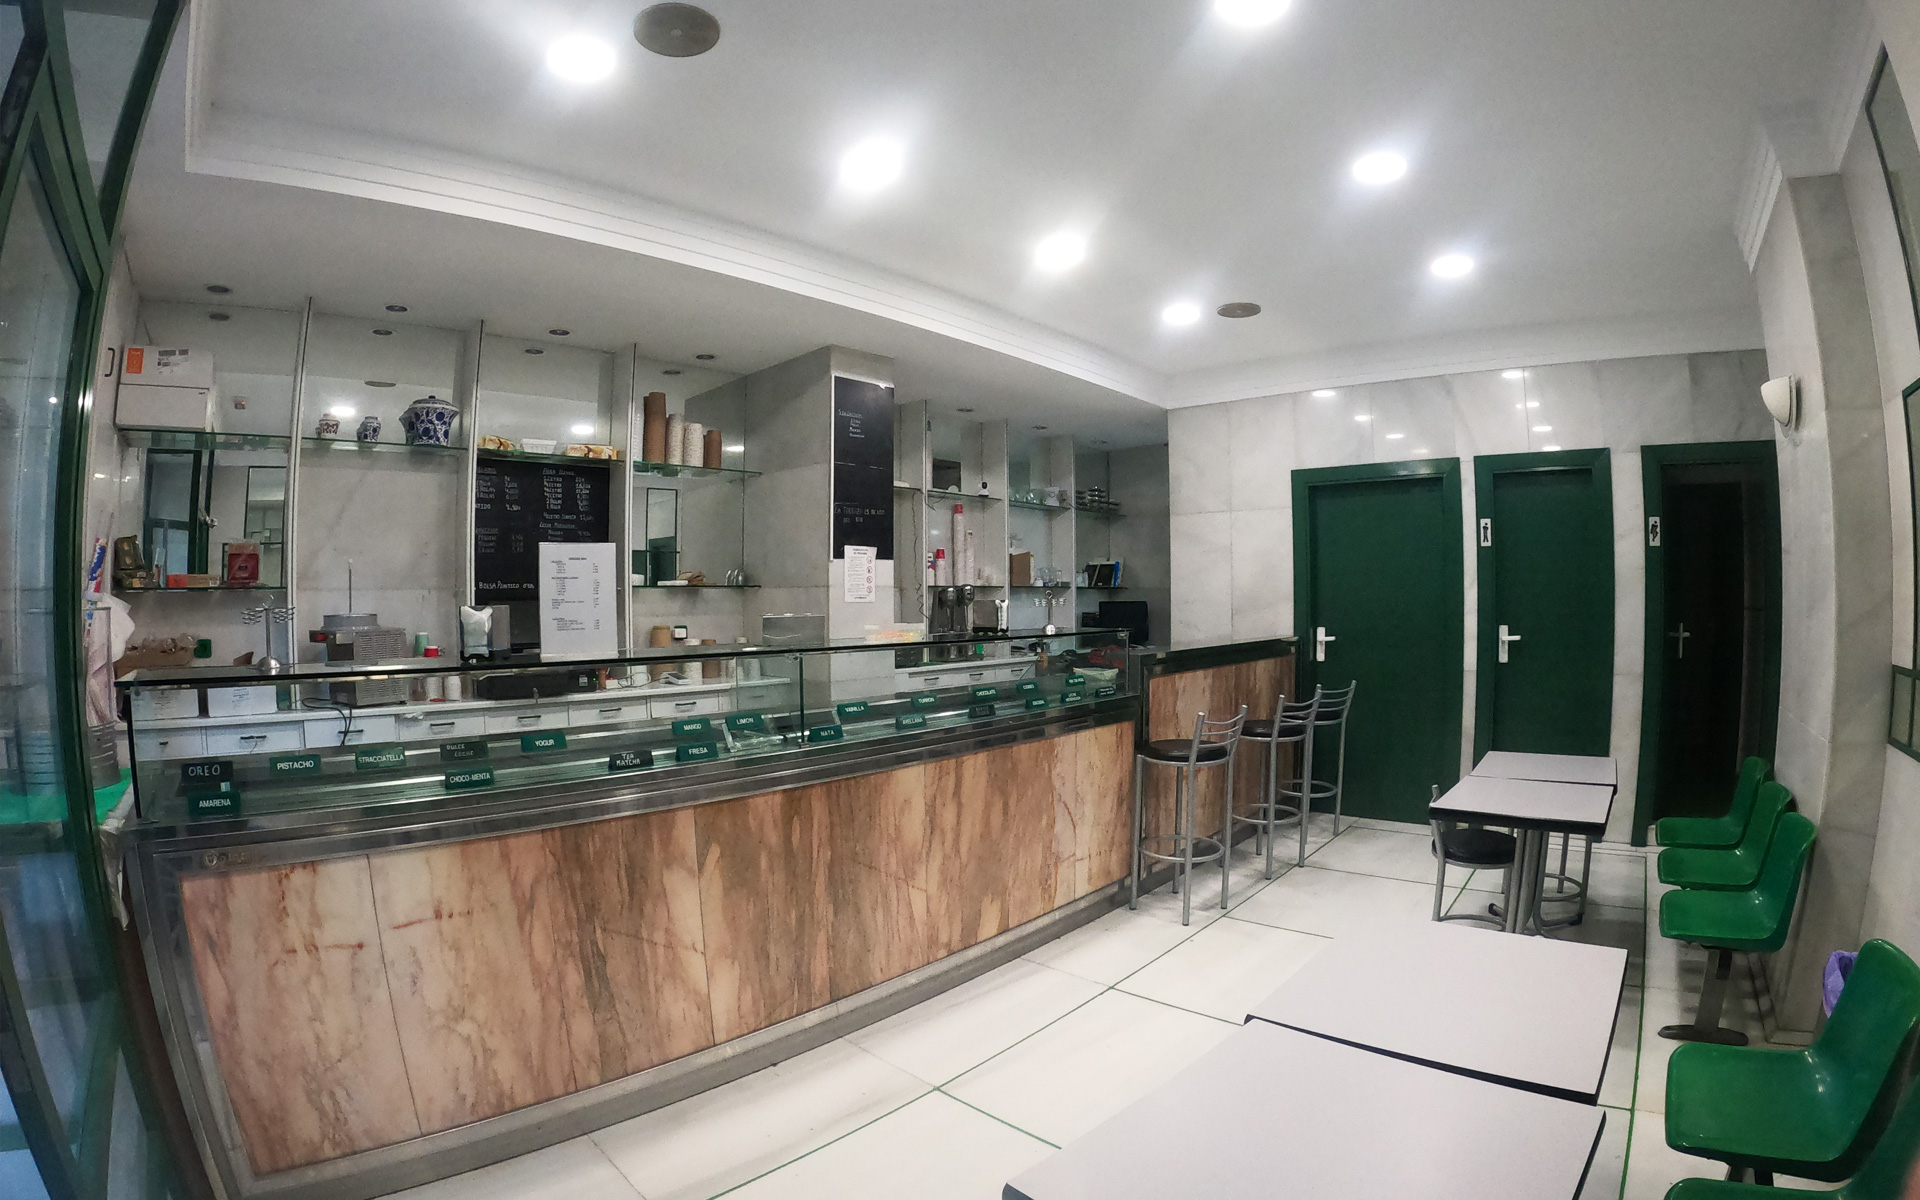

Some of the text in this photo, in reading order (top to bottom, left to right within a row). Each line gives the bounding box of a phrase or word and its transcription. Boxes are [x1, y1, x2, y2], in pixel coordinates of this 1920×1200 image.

[478, 581, 497, 589] BOLSA
[683, 723, 702, 731] MANGO
[534, 738, 555, 747] YOGUR
[688, 746, 708, 755] FRESA
[358, 753, 405, 764] STRACCIATELLA
[616, 758, 641, 767] MATCHA
[276, 759, 315, 771] PISTACHO
[187, 764, 221, 777] OREO
[449, 773, 491, 784] CHOCO-MENTA
[198, 798, 231, 809] AMARENA
